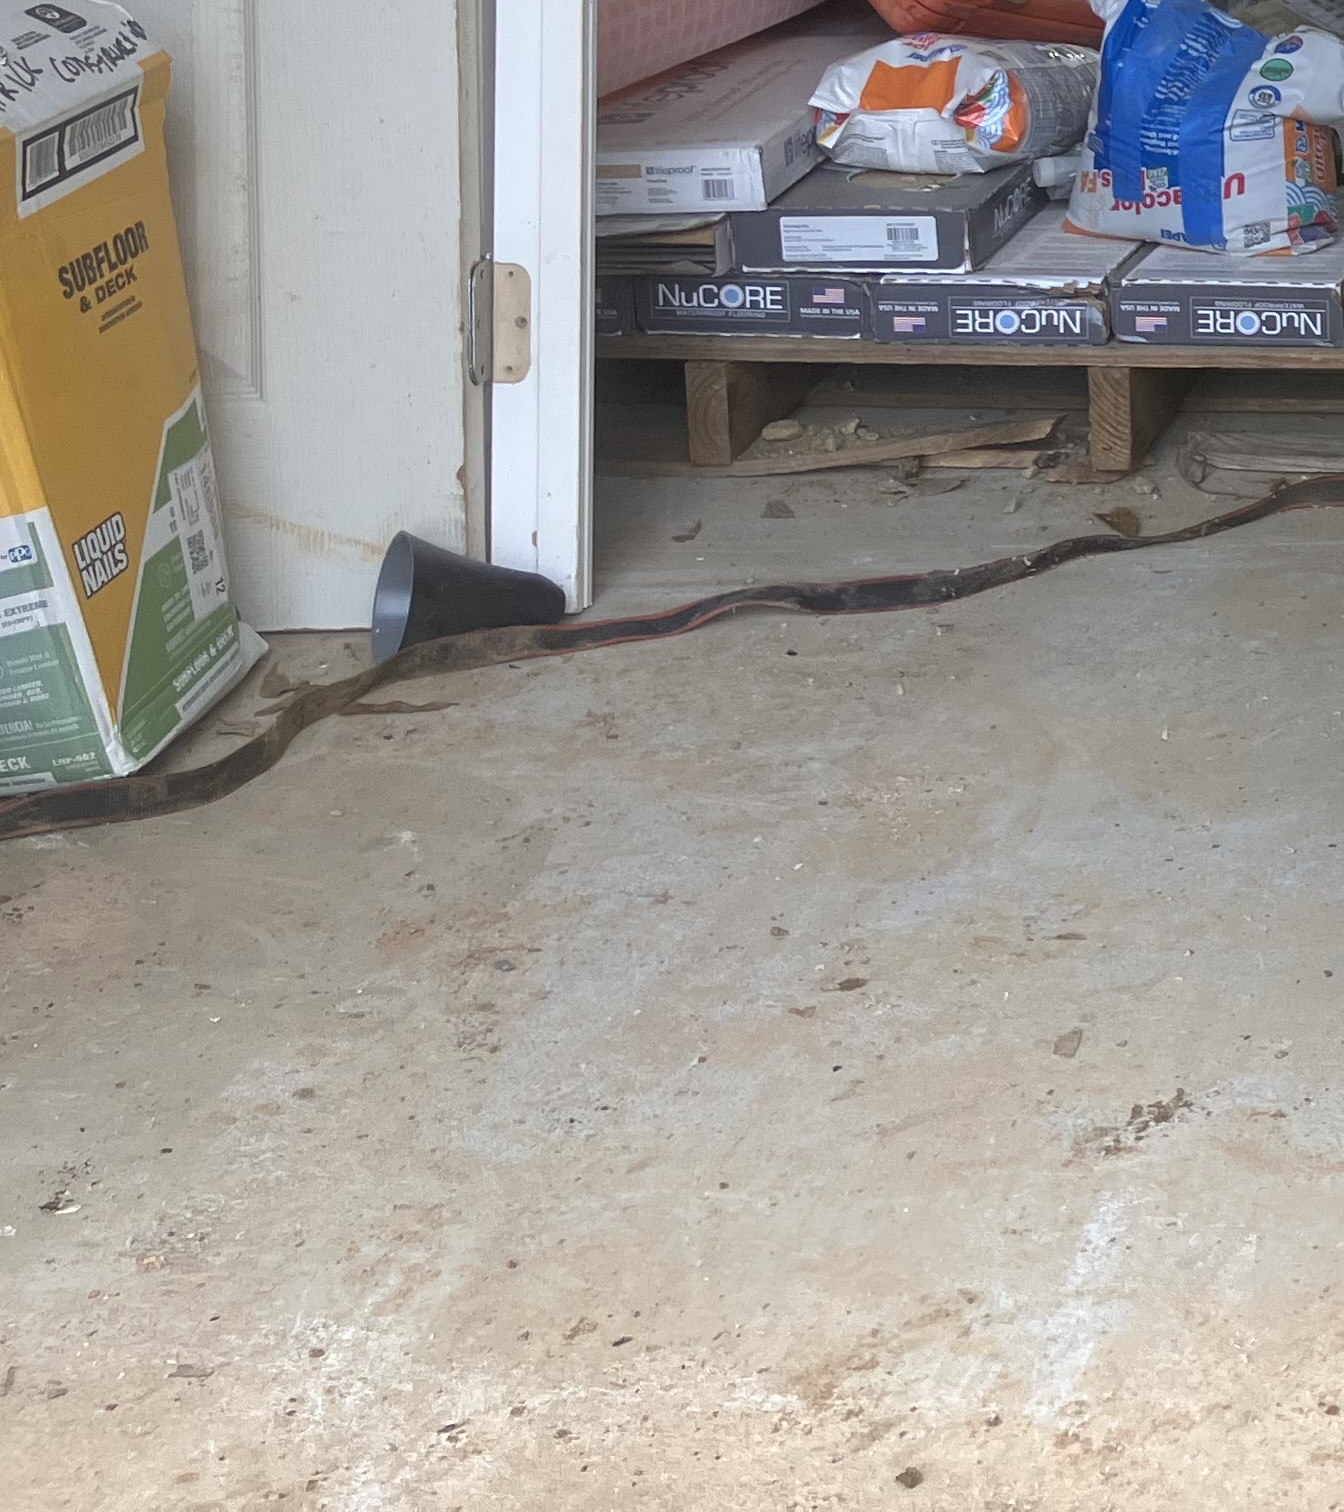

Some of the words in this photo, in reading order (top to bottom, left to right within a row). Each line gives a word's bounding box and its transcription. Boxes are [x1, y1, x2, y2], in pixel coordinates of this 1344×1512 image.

[58, 220, 150, 300] SUBFLOOR
[79, 295, 93, 314] &
[94, 264, 138, 305] DECK
[657, 283, 784, 310] NuCORE
[954, 309, 1082, 335] NuCORE
[1196, 310, 1321, 336] NuCORE
[73, 512, 126, 568] LIQUID
[82, 542, 128, 599] NAILS
[0, 755, 31, 773] ECK
